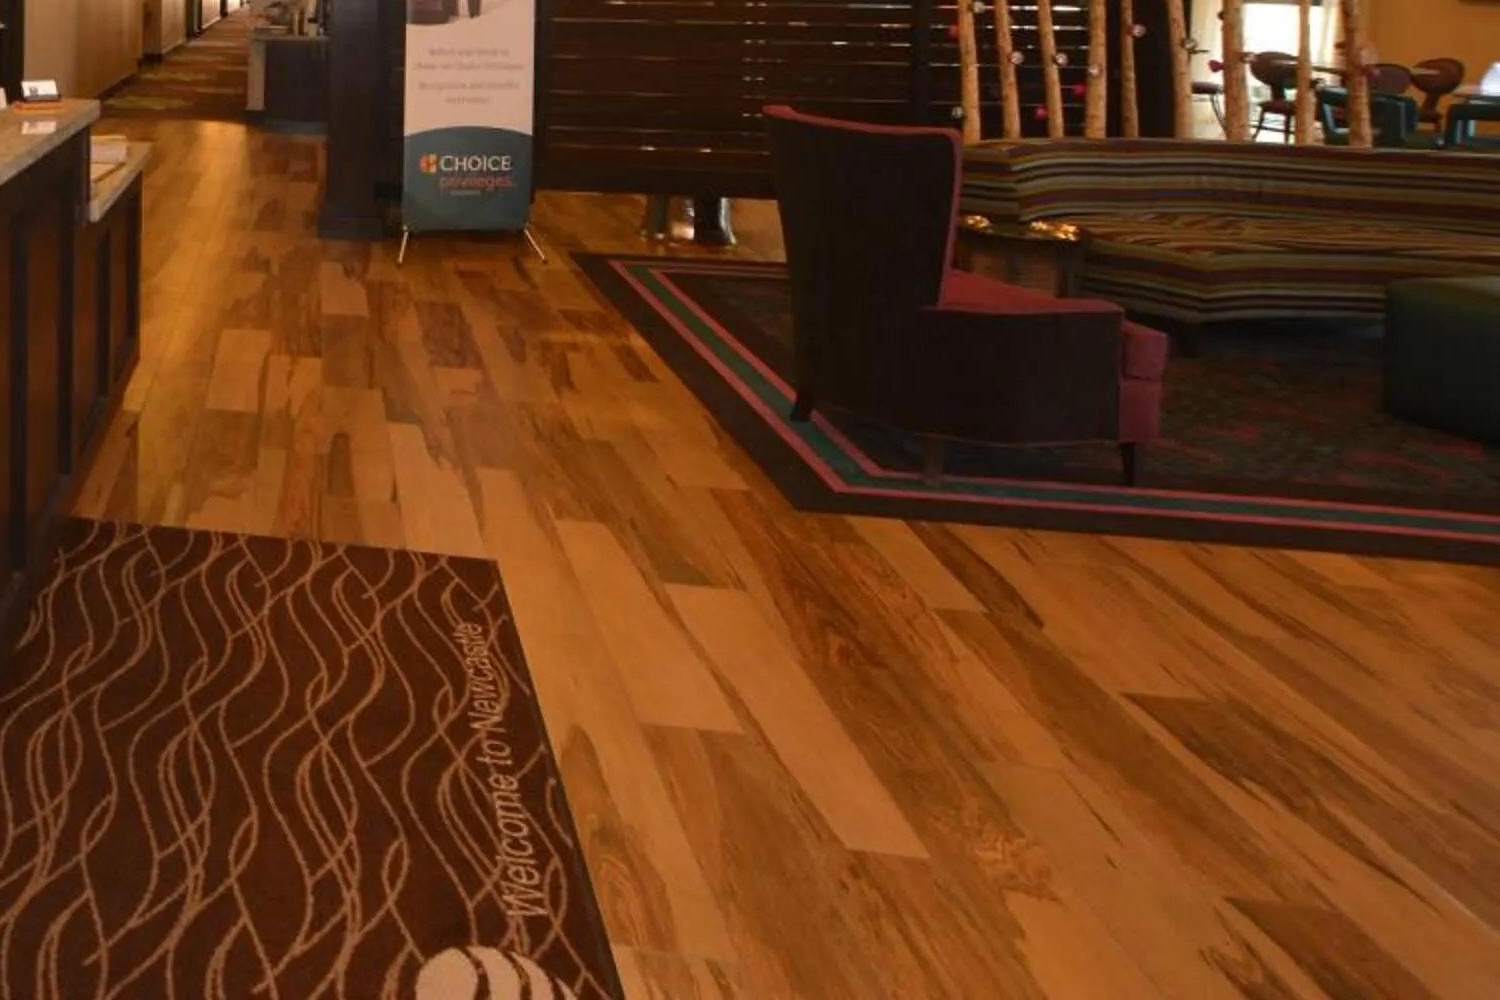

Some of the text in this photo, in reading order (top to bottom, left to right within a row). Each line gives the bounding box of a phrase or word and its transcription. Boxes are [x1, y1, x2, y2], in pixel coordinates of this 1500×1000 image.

[440, 155, 512, 171] CHOICE
[454, 621, 548, 918] Welcome to Newcastle
